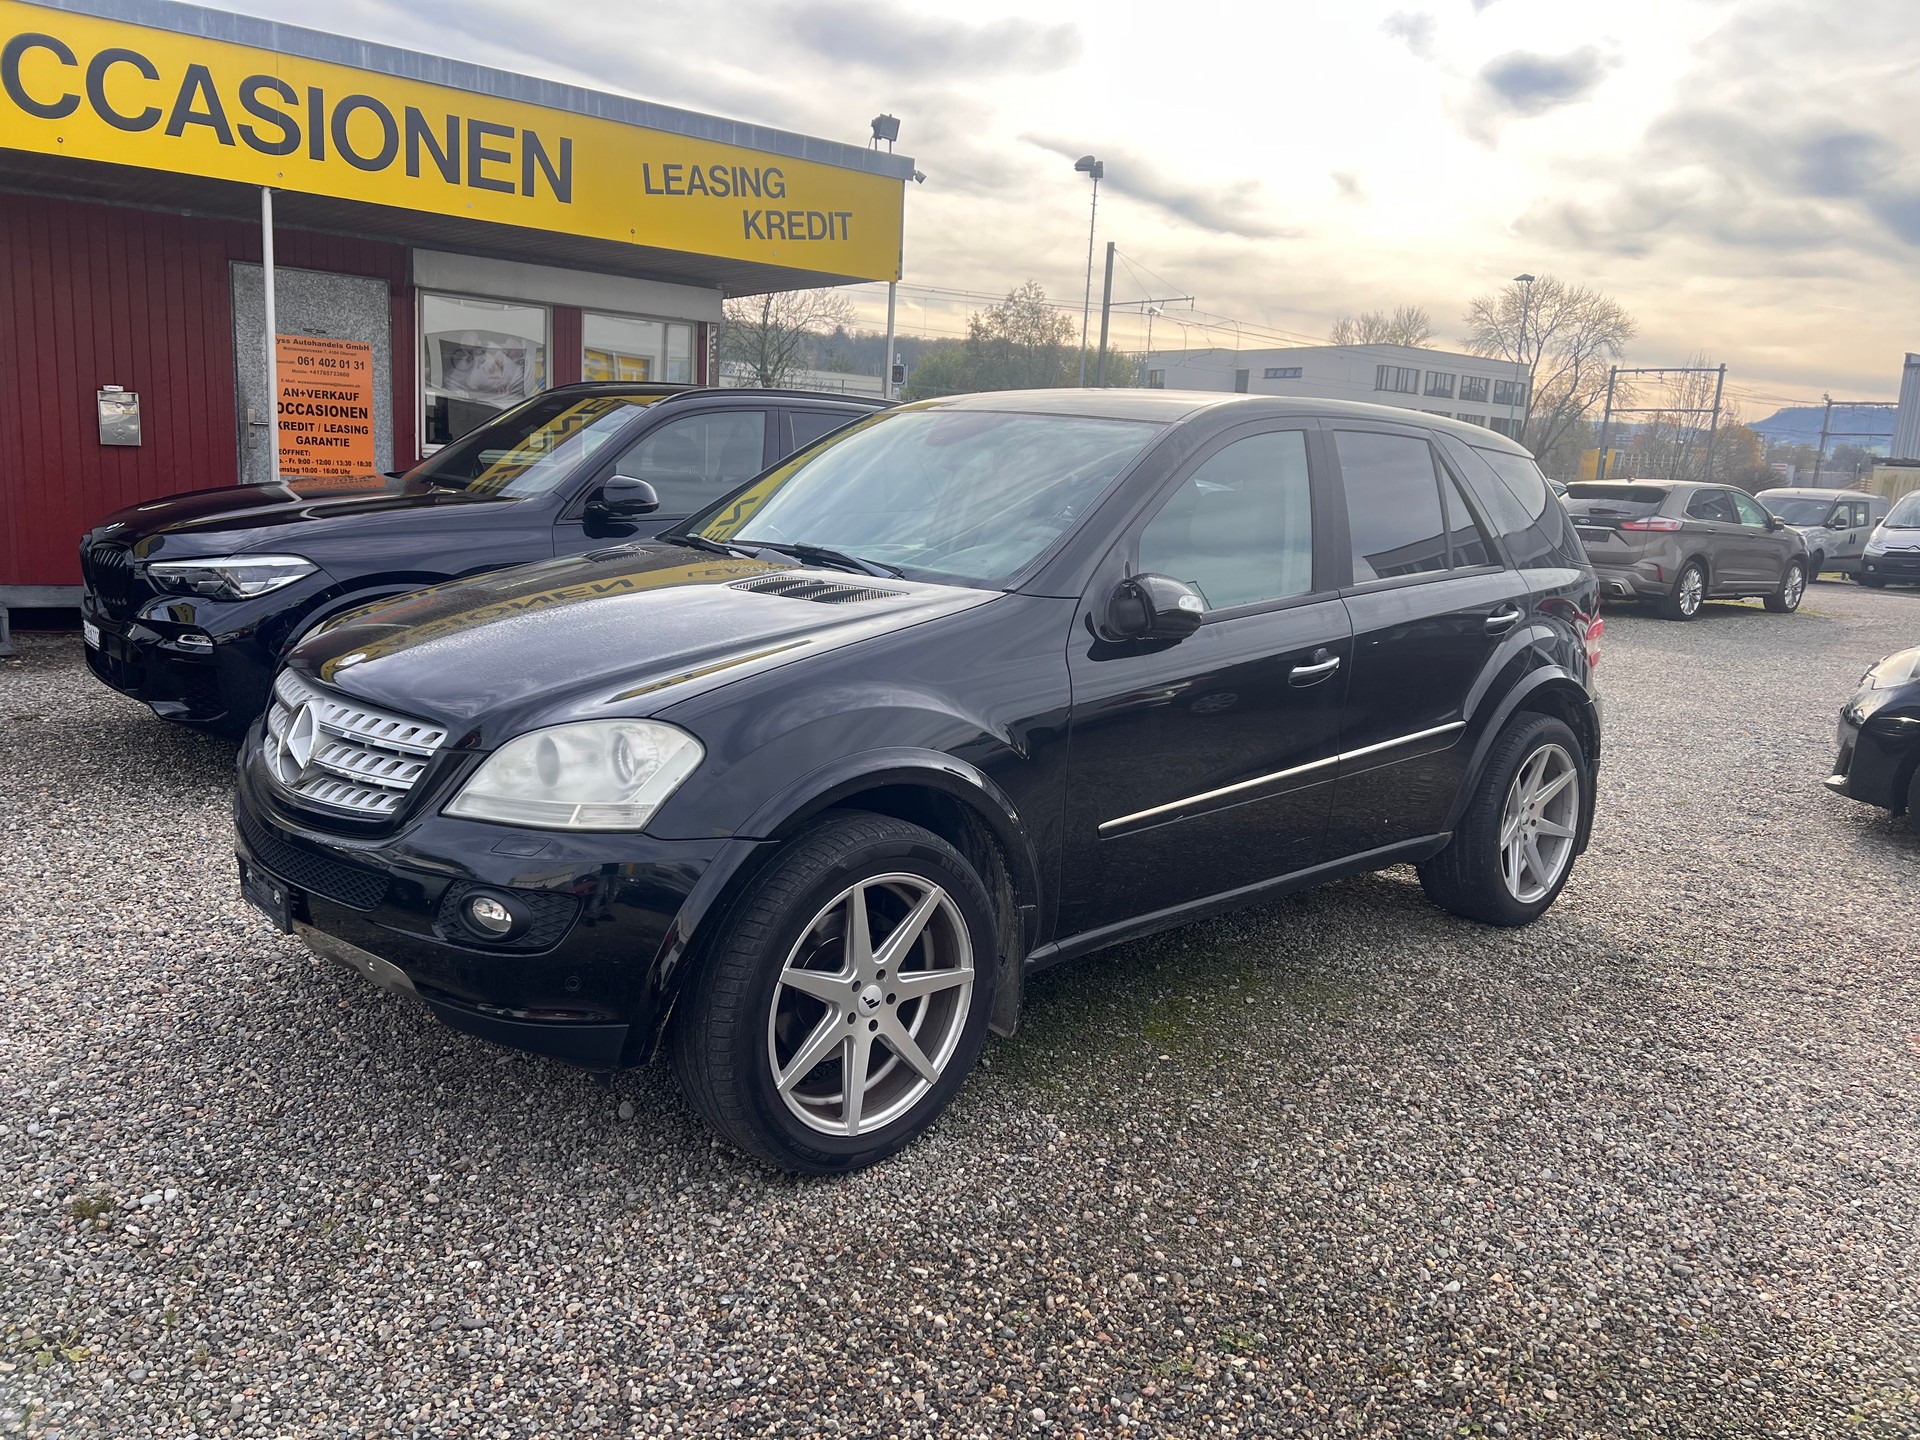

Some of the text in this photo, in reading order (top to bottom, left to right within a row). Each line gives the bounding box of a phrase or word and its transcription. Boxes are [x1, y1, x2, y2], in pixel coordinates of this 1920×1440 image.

[642, 162, 786, 199] LEASING
[742, 209, 853, 241] KREDIT
[293, 338, 343, 349] Autohandels
[346, 343, 370, 351] GmbH
[297, 356, 315, 367] 061
[319, 358, 336, 368] 402
[339, 360, 350, 370] 01
[354, 361, 365, 371] 31
[283, 387, 359, 402] AN+VERKAUF
[277, 401, 368, 420] OCCASIONEN
[324, 423, 369, 435] LEASING
[296, 436, 350, 448] GARANTIE
[278, 448, 311, 457] EÖFFNET:
[302, 466, 317, 474] 10:00
